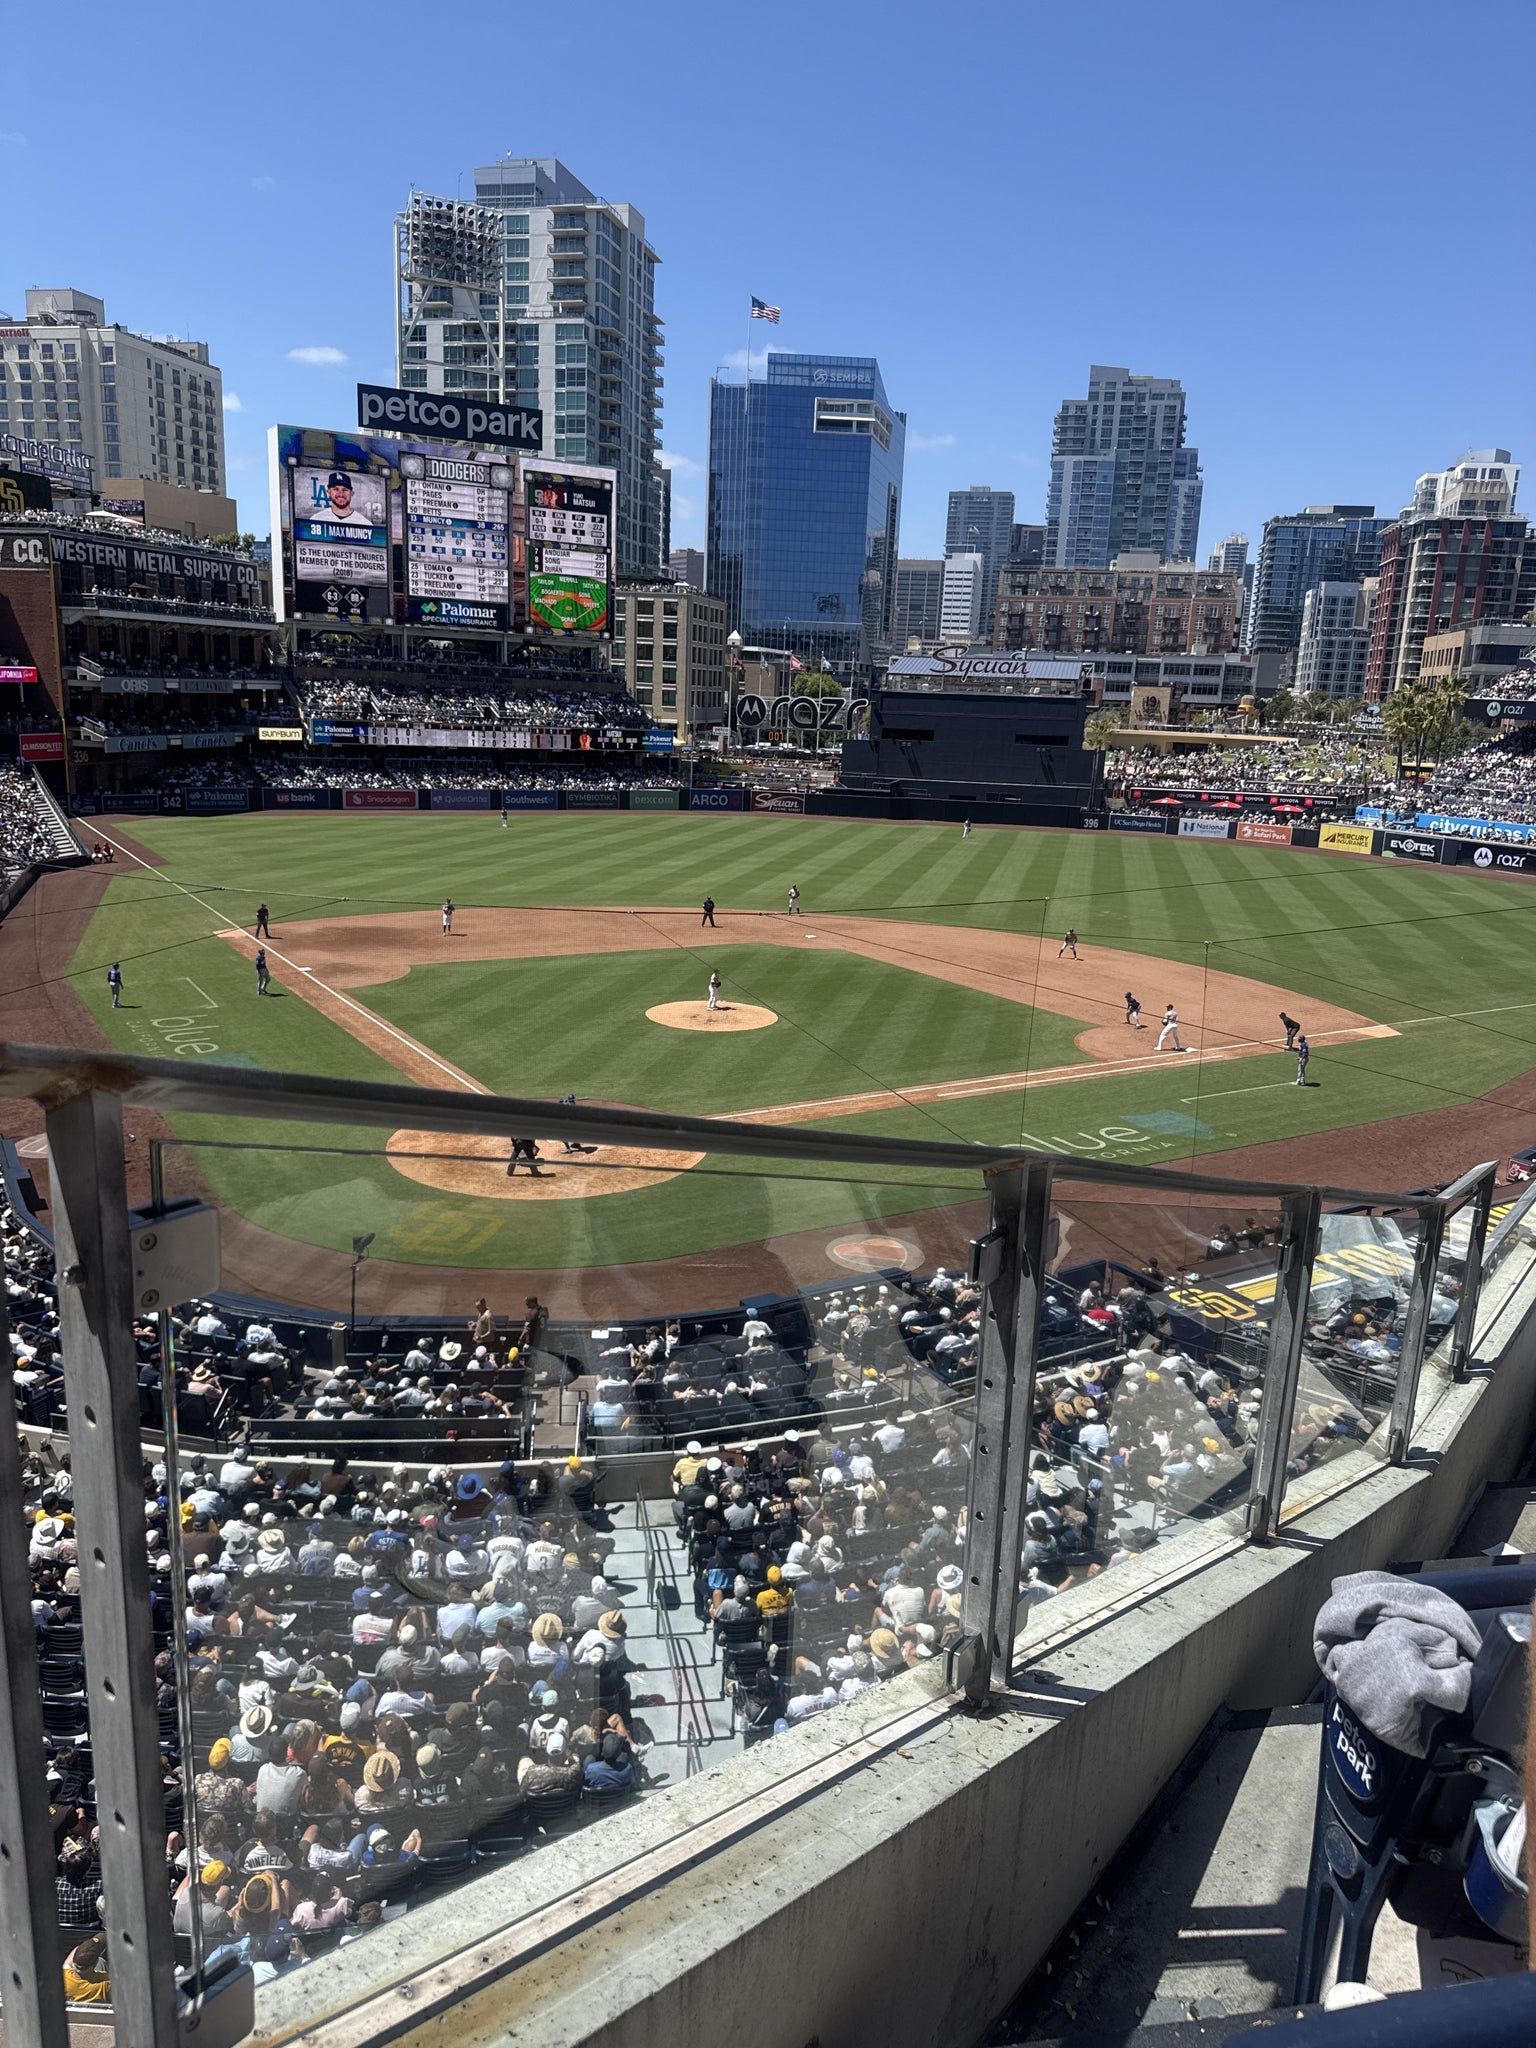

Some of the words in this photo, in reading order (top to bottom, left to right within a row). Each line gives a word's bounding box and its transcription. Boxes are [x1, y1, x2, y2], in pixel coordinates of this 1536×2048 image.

[830, 373, 871, 384] SEMPRA
[362, 394, 460, 428] petco
[467, 408, 539, 440] park
[432, 460, 484, 482] DODGERS
[423, 482, 445, 490] OHTANI
[423, 491, 442, 499] PAGES
[563, 492, 567, 504] 1
[423, 499, 452, 508] FREEMAN
[573, 499, 595, 508] MATSUI
[311, 525, 321, 535] 3B
[329, 526, 344, 537] MAX
[345, 527, 372, 540] MUNCY
[12, 538, 49, 564] CO.
[300, 548, 307, 556] IS
[308, 548, 321, 557] THE
[322, 550, 352, 559] LONGEST
[354, 552, 384, 562] TENURED
[545, 549, 570, 557] ANDUJAR
[52, 538, 127, 568] WESTERN
[134, 550, 180, 575] METAL
[184, 558, 232, 581] SUPPLY
[236, 566, 258, 584] CO.
[300, 557, 328, 566] MEMBER
[340, 559, 353, 568] THE
[355, 561, 385, 570] DODGERS
[333, 568, 353, 578] (2018)
[424, 564, 445, 572] EDMAN
[425, 581, 455, 589] FREELAND
[425, 589, 455, 597] ROBINSON
[441, 602, 496, 618] Palomar
[422, 615, 458, 623] SPECIALTY
[460, 618, 497, 627] INSURANCE
[930, 646, 1030, 682] Sycuan
[121, 679, 148, 692] ORIS
[770, 695, 869, 730] razr
[1503, 706, 1525, 714] razr
[74, 750, 88, 762] 336
[204, 791, 244, 801] Palomar
[291, 793, 315, 802] bank
[367, 795, 410, 803] Snapdragon
[505, 796, 548, 804] Southwest
[692, 795, 728, 805] ARCO
[163, 797, 181, 808] 342
[754, 793, 798, 811] Sycuan
[1084, 818, 1098, 828] 396
[1196, 822, 1225, 831] National
[1337, 833, 1369, 842] MERCURY
[1336, 839, 1368, 848] INSURANCE
[1390, 839, 1435, 852] EVOTEK
[1497, 855, 1526, 867] razr
[151, 1014, 219, 1055] blue
[1333, 1703, 1376, 1772] petco
[332, 1748, 357, 1759] GWYNN
[1337, 1732, 1372, 1791] park
[421, 1784, 447, 1795] MILLER
[246, 1855, 286, 1868] WINFIELD
